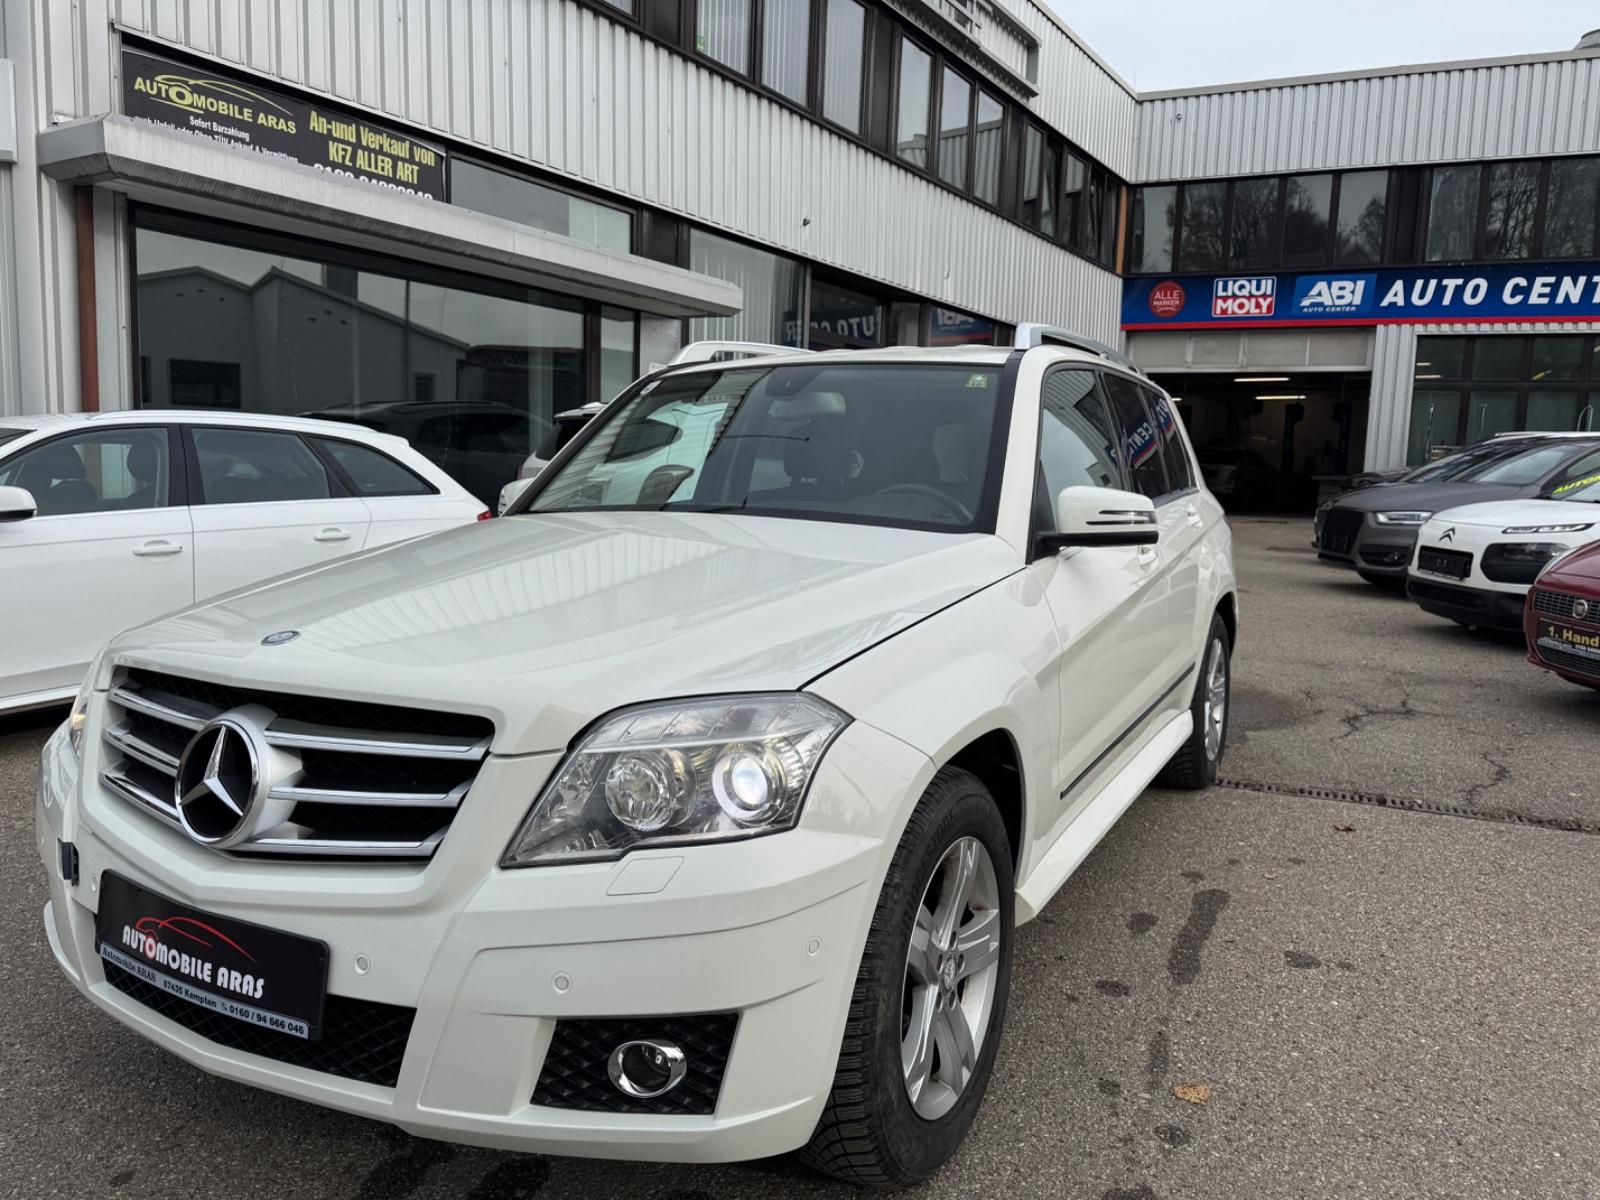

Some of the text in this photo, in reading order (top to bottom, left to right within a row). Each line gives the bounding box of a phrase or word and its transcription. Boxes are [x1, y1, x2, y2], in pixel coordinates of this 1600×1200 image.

[134, 77, 297, 134] AUTOMOBILE ARAS
[189, 115, 250, 142] Sofort Barzahlung
[309, 110, 436, 167] An-und Verkauf von
[328, 140, 353, 167] KFZ
[356, 149, 393, 178] ALLER
[396, 160, 419, 184] ART
[1153, 290, 1180, 300] ALLE
[1217, 279, 1272, 297] LIQUI
[1299, 279, 1365, 306] ABI
[1380, 278, 1488, 307] AUTO
[1215, 297, 1273, 315] MOLY
[1548, 626, 1600, 647] 1. Hand
[122, 925, 265, 999] AUTOMOBILE ARAS
[102, 946, 136, 972] Automobile
[137, 963, 157, 983] ARAS
[162, 980, 183, 995] 87435
[184, 988, 217, 1009] Kempten
[229, 1005, 250, 1018] 0160
[256, 1013, 267, 1025] 94
[269, 1017, 285, 1029] 666
[288, 1022, 305, 1035] 046
